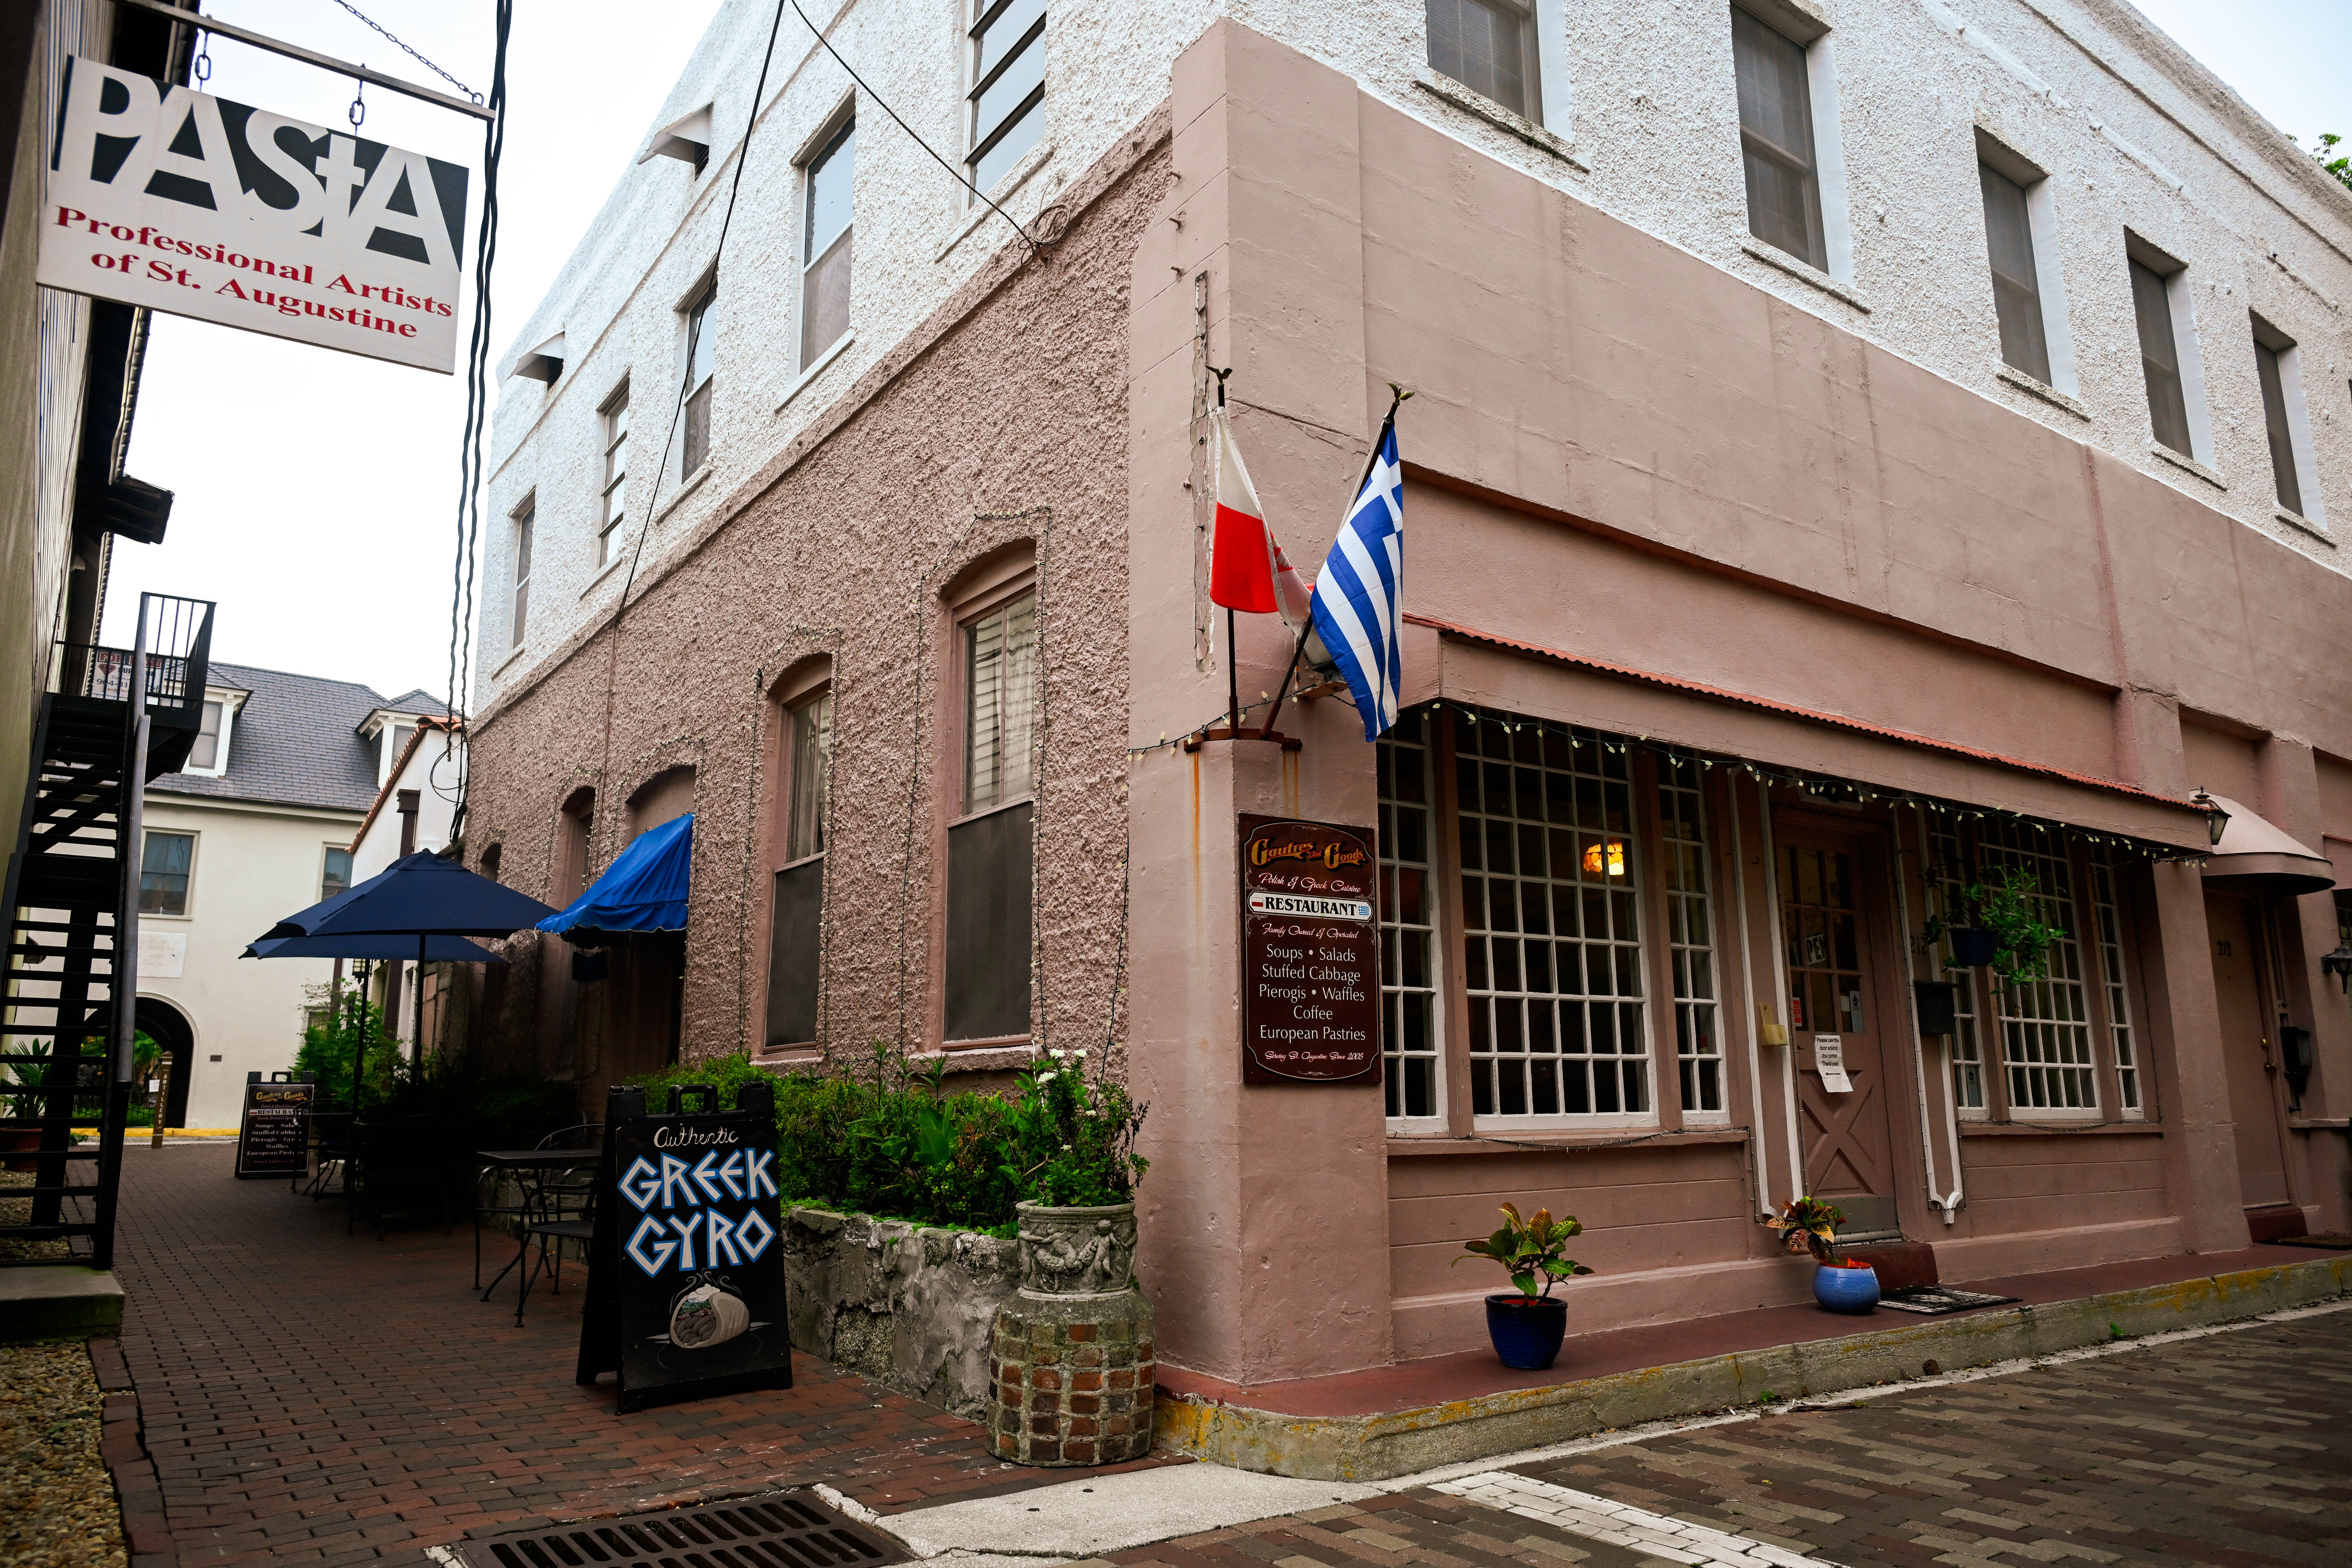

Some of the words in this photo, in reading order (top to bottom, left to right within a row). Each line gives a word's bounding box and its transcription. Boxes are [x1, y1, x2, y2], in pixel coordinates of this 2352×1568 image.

[54, 205, 313, 284] Professional
[325, 274, 451, 317] Artists
[91, 254, 140, 273] of
[147, 260, 201, 289] St.
[214, 279, 417, 337] Augustine
[1251, 838, 1314, 866] Gaufres
[1324, 842, 1365, 869] Goods
[1258, 872, 1285, 885] Polish
[1287, 876, 1298, 889] &
[1301, 877, 1328, 891] Greek
[1331, 880, 1361, 892] Cuisine
[1265, 897, 1357, 916] RESTAURANT
[1263, 923, 1286, 937] Family
[1288, 925, 1315, 936] Owned
[1316, 928, 1325, 939] &
[1327, 928, 1359, 939] Operated
[1267, 944, 1303, 963] Soups
[1320, 947, 1355, 962] Salads
[2218, 940, 2232, 957] 212
[1263, 963, 1305, 979] Stuffed
[1309, 966, 1361, 986] Cabbage
[1259, 984, 1306, 1003] Pierogis
[1322, 986, 1365, 1001] Waffles
[1293, 1005, 1333, 1020] Coffee
[1260, 1024, 1318, 1043] European
[1323, 1027, 1366, 1040] Pastries
[1265, 1051, 1286, 1061] Serving
[1301, 1051, 1328, 1062] Augustine
[1329, 1052, 1346, 1060] Since
[158, 1074, 168, 1125] ARTILLERY
[256, 1092, 282, 1100] Gaufres
[284, 1092, 304, 1100] Goods
[654, 1126, 738, 1148] Authentic
[618, 1148, 779, 1212] GREEK
[624, 1206, 776, 1278] GYRO
